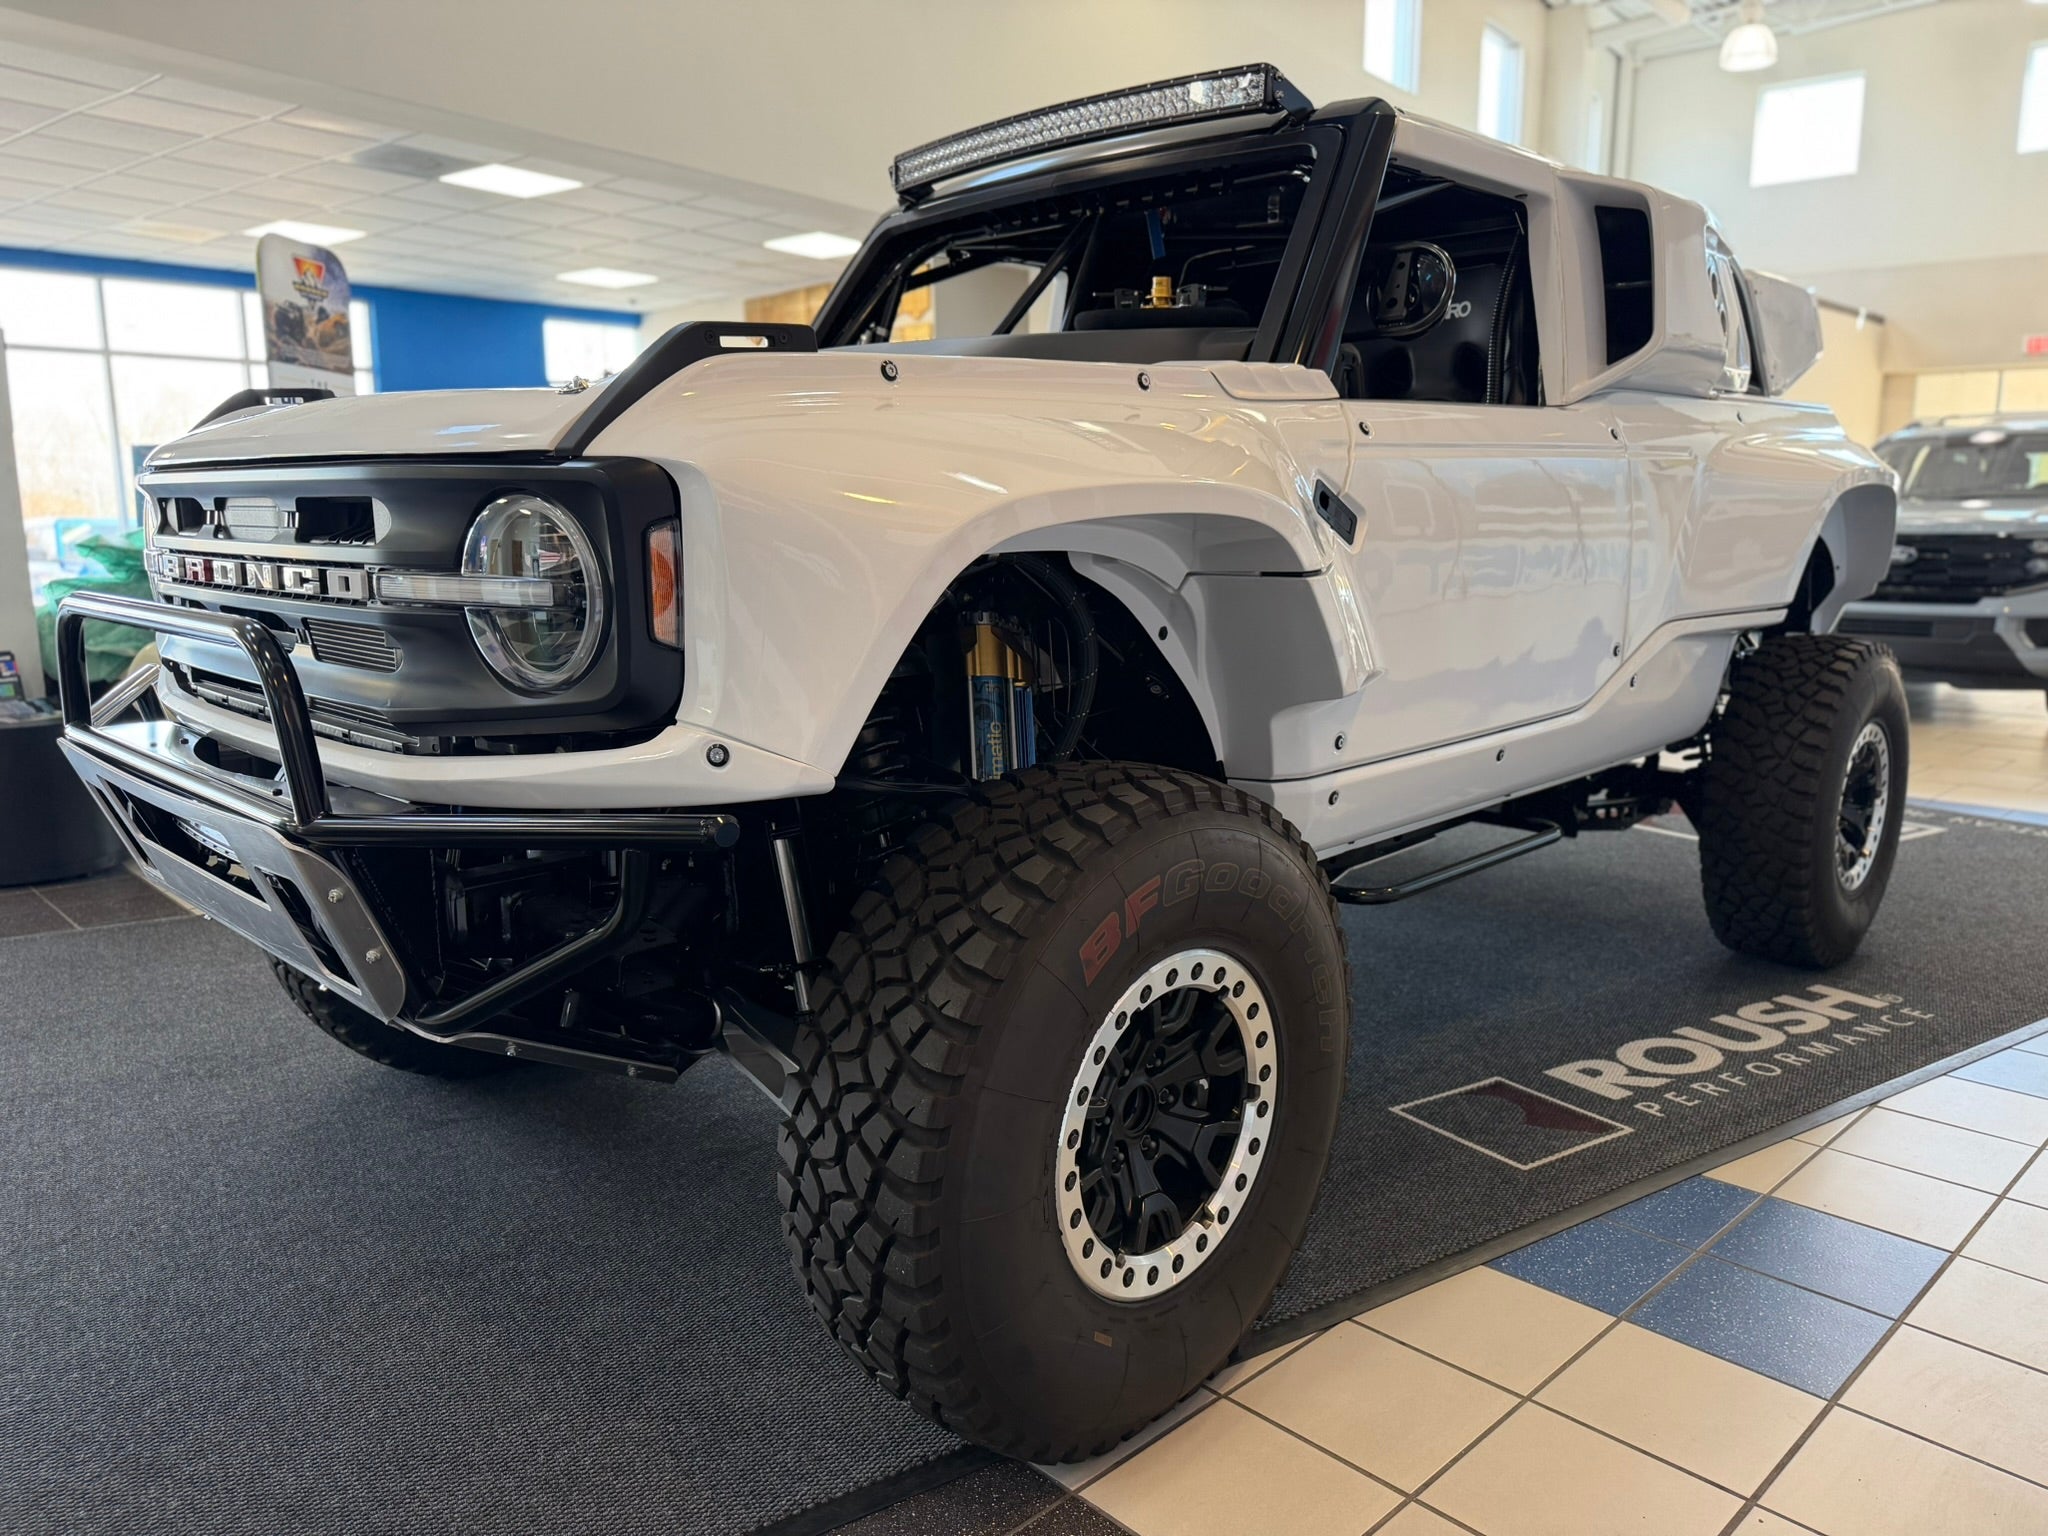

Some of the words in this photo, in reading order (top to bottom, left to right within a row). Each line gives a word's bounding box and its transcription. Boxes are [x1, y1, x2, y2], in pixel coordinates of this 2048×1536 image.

[162, 554, 369, 600] BRONCO
[1543, 984, 1890, 1100] ROUSH
[1633, 1008, 1936, 1117] PERFORMANCE
